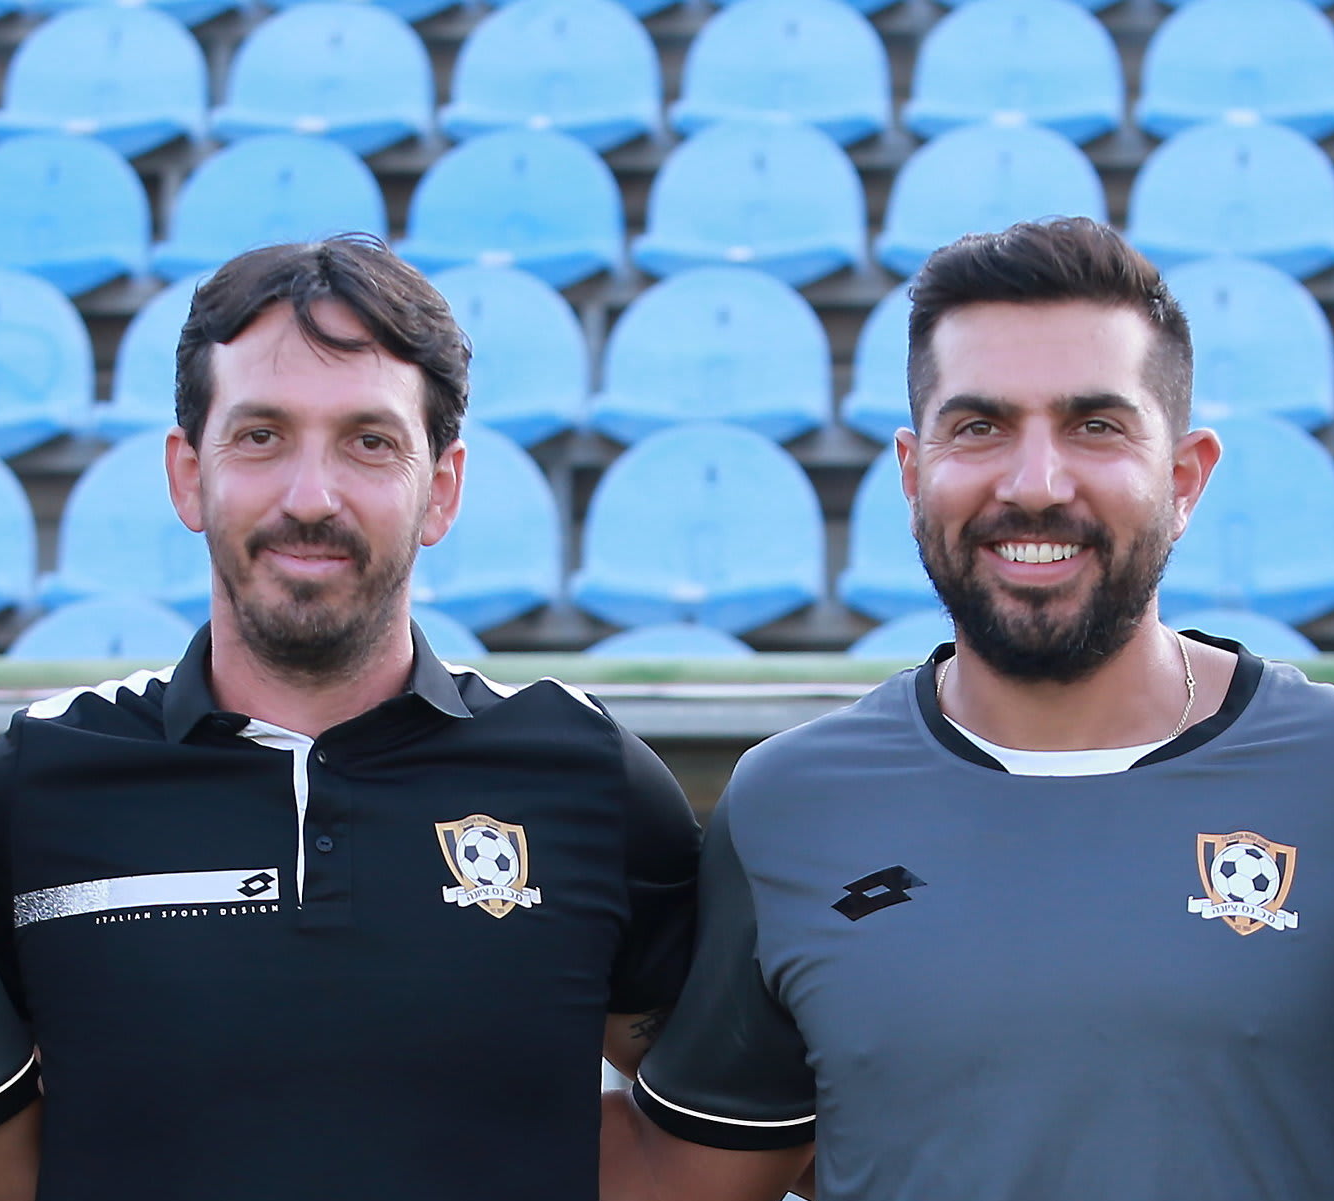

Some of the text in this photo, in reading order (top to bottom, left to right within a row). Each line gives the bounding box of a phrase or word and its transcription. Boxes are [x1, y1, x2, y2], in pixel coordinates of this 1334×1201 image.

[95, 905, 279, 924] ITALIAN SPORT DESIGN
